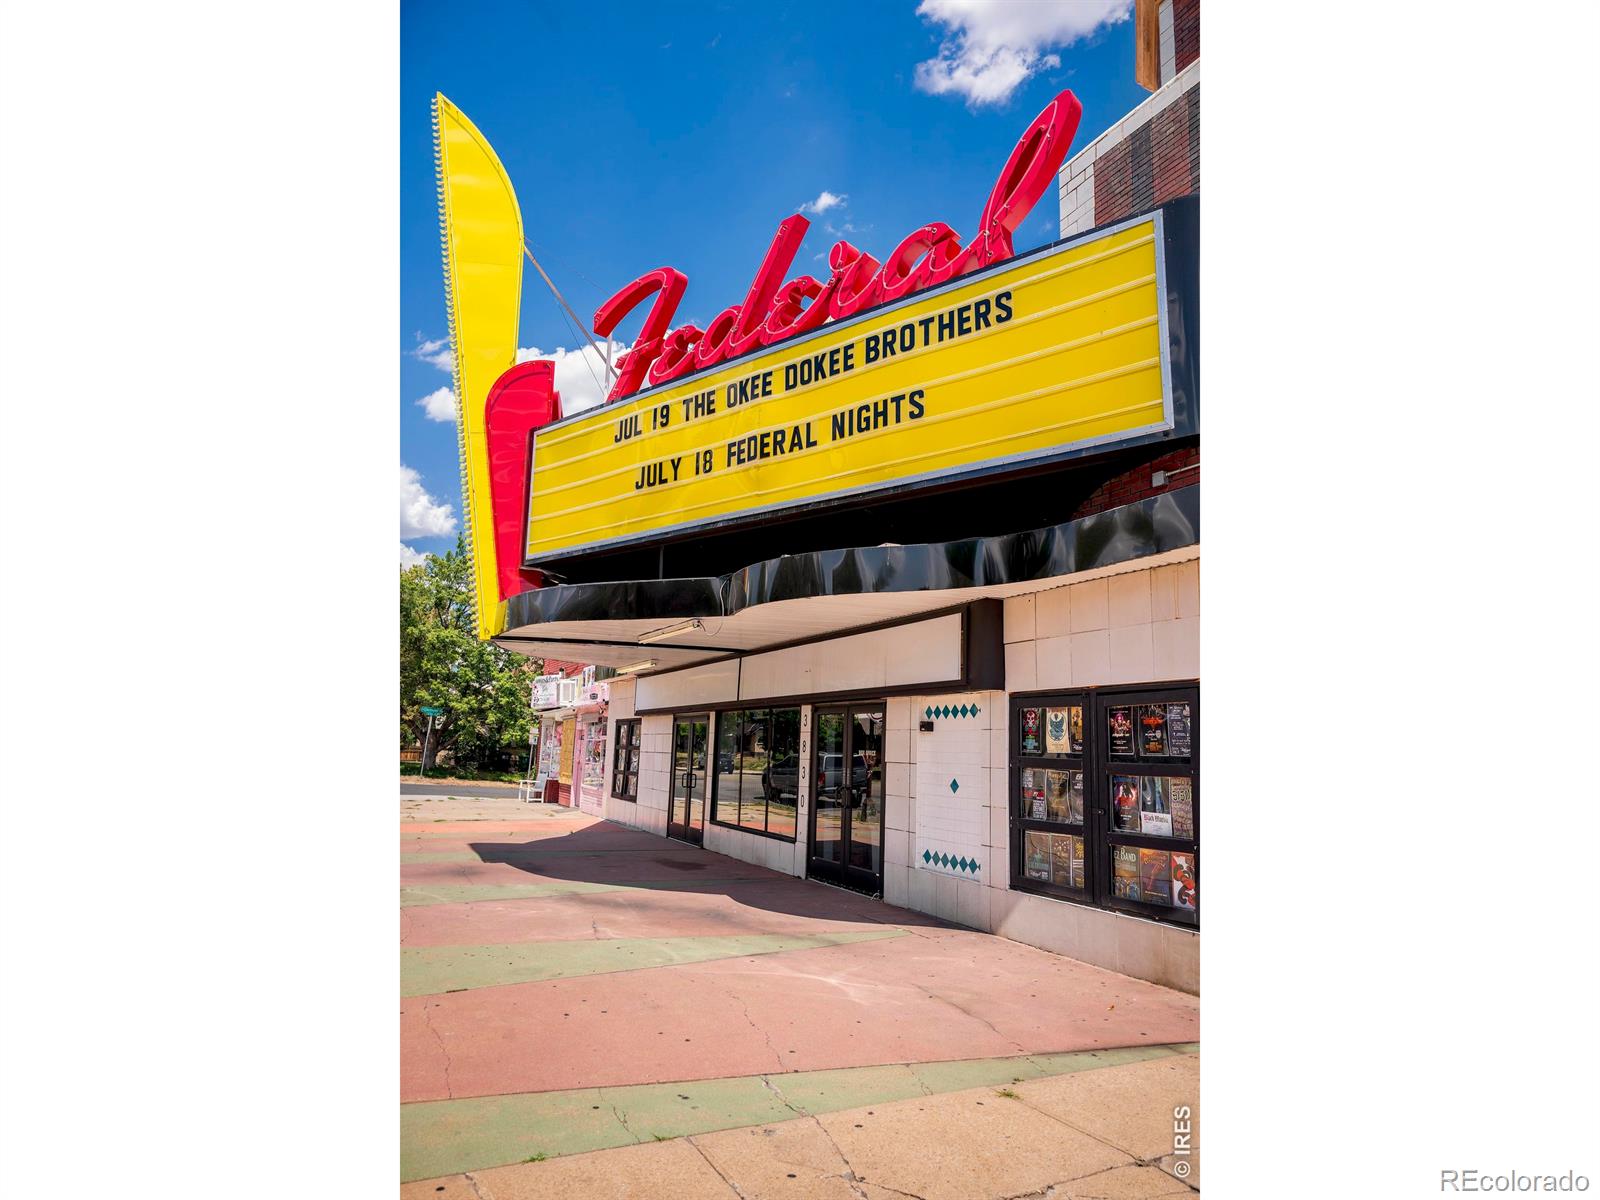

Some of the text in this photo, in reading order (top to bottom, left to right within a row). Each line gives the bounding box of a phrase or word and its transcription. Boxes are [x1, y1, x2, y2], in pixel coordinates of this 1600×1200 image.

[593, 89, 1083, 405] Federal
[614, 291, 1013, 444] JUL 19 THE OKEE DOKEE BROTHERS
[634, 389, 926, 491] JULY 18 FEDERAL NIGHTS
